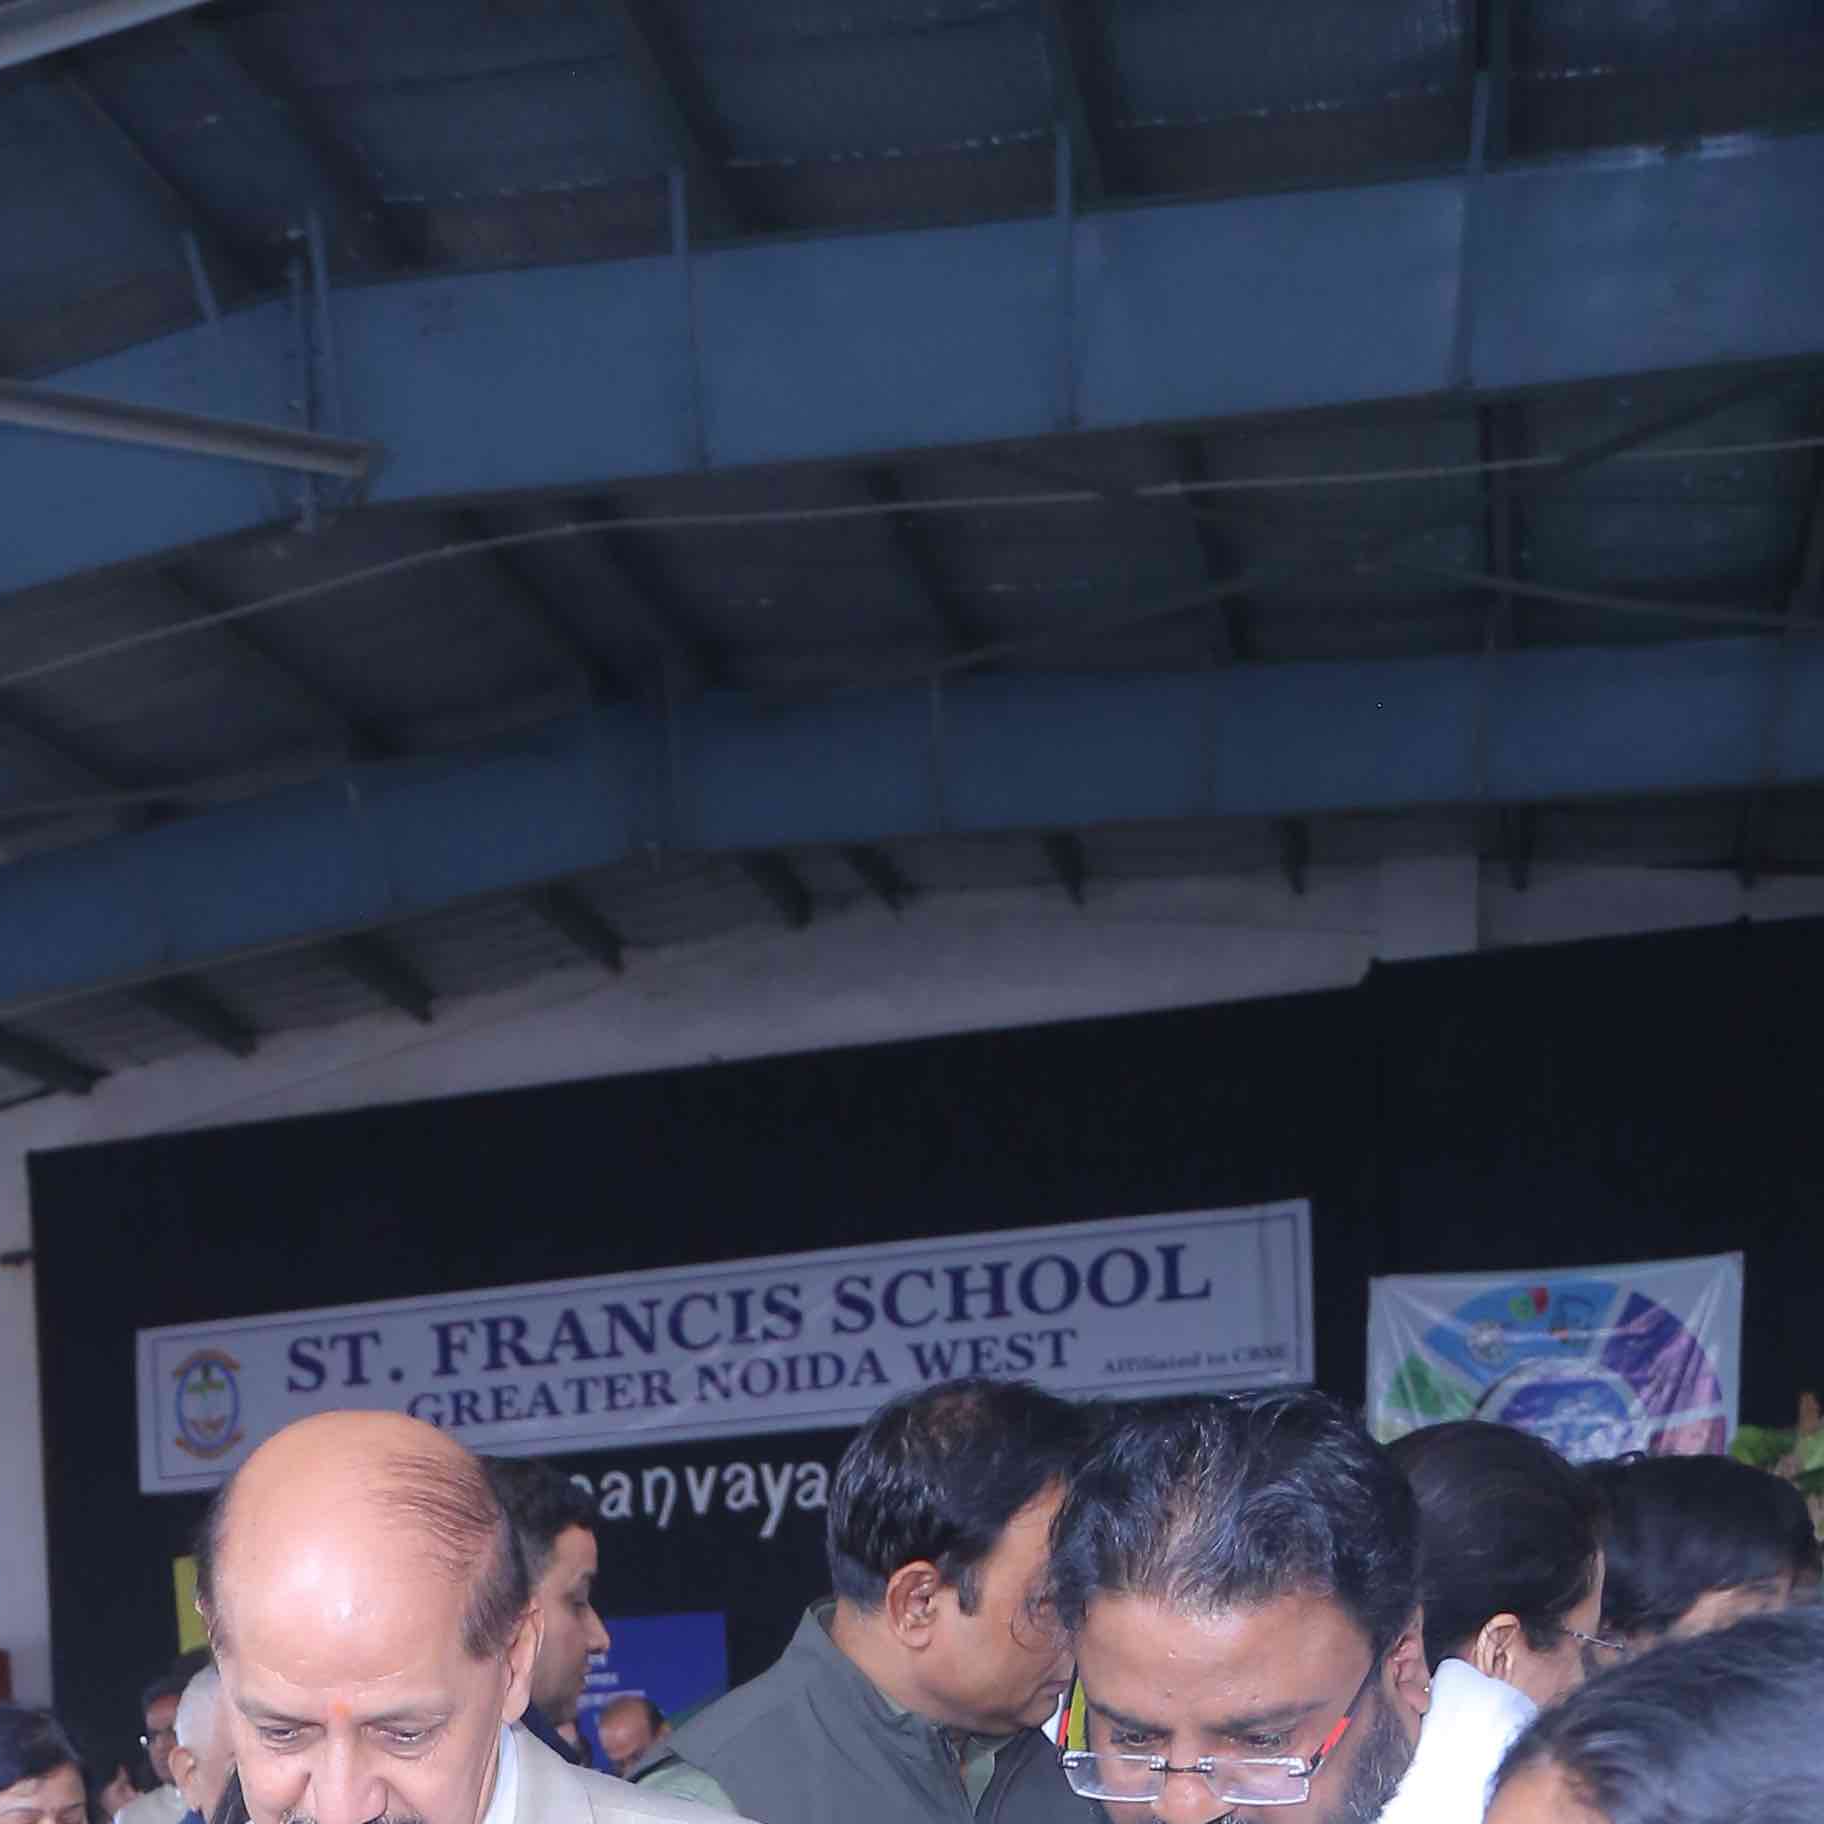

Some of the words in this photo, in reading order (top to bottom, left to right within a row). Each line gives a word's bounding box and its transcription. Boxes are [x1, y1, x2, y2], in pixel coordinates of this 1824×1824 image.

[286, 1329, 405, 1394] ST.
[429, 1281, 804, 1378] FRANCIS
[831, 1242, 1213, 1336] SCHOOL
[406, 1367, 676, 1429] GREATER
[694, 1348, 891, 1404] NOIDA
[907, 1328, 1079, 1381] WEST
[569, 1461, 828, 1539] anvaya
